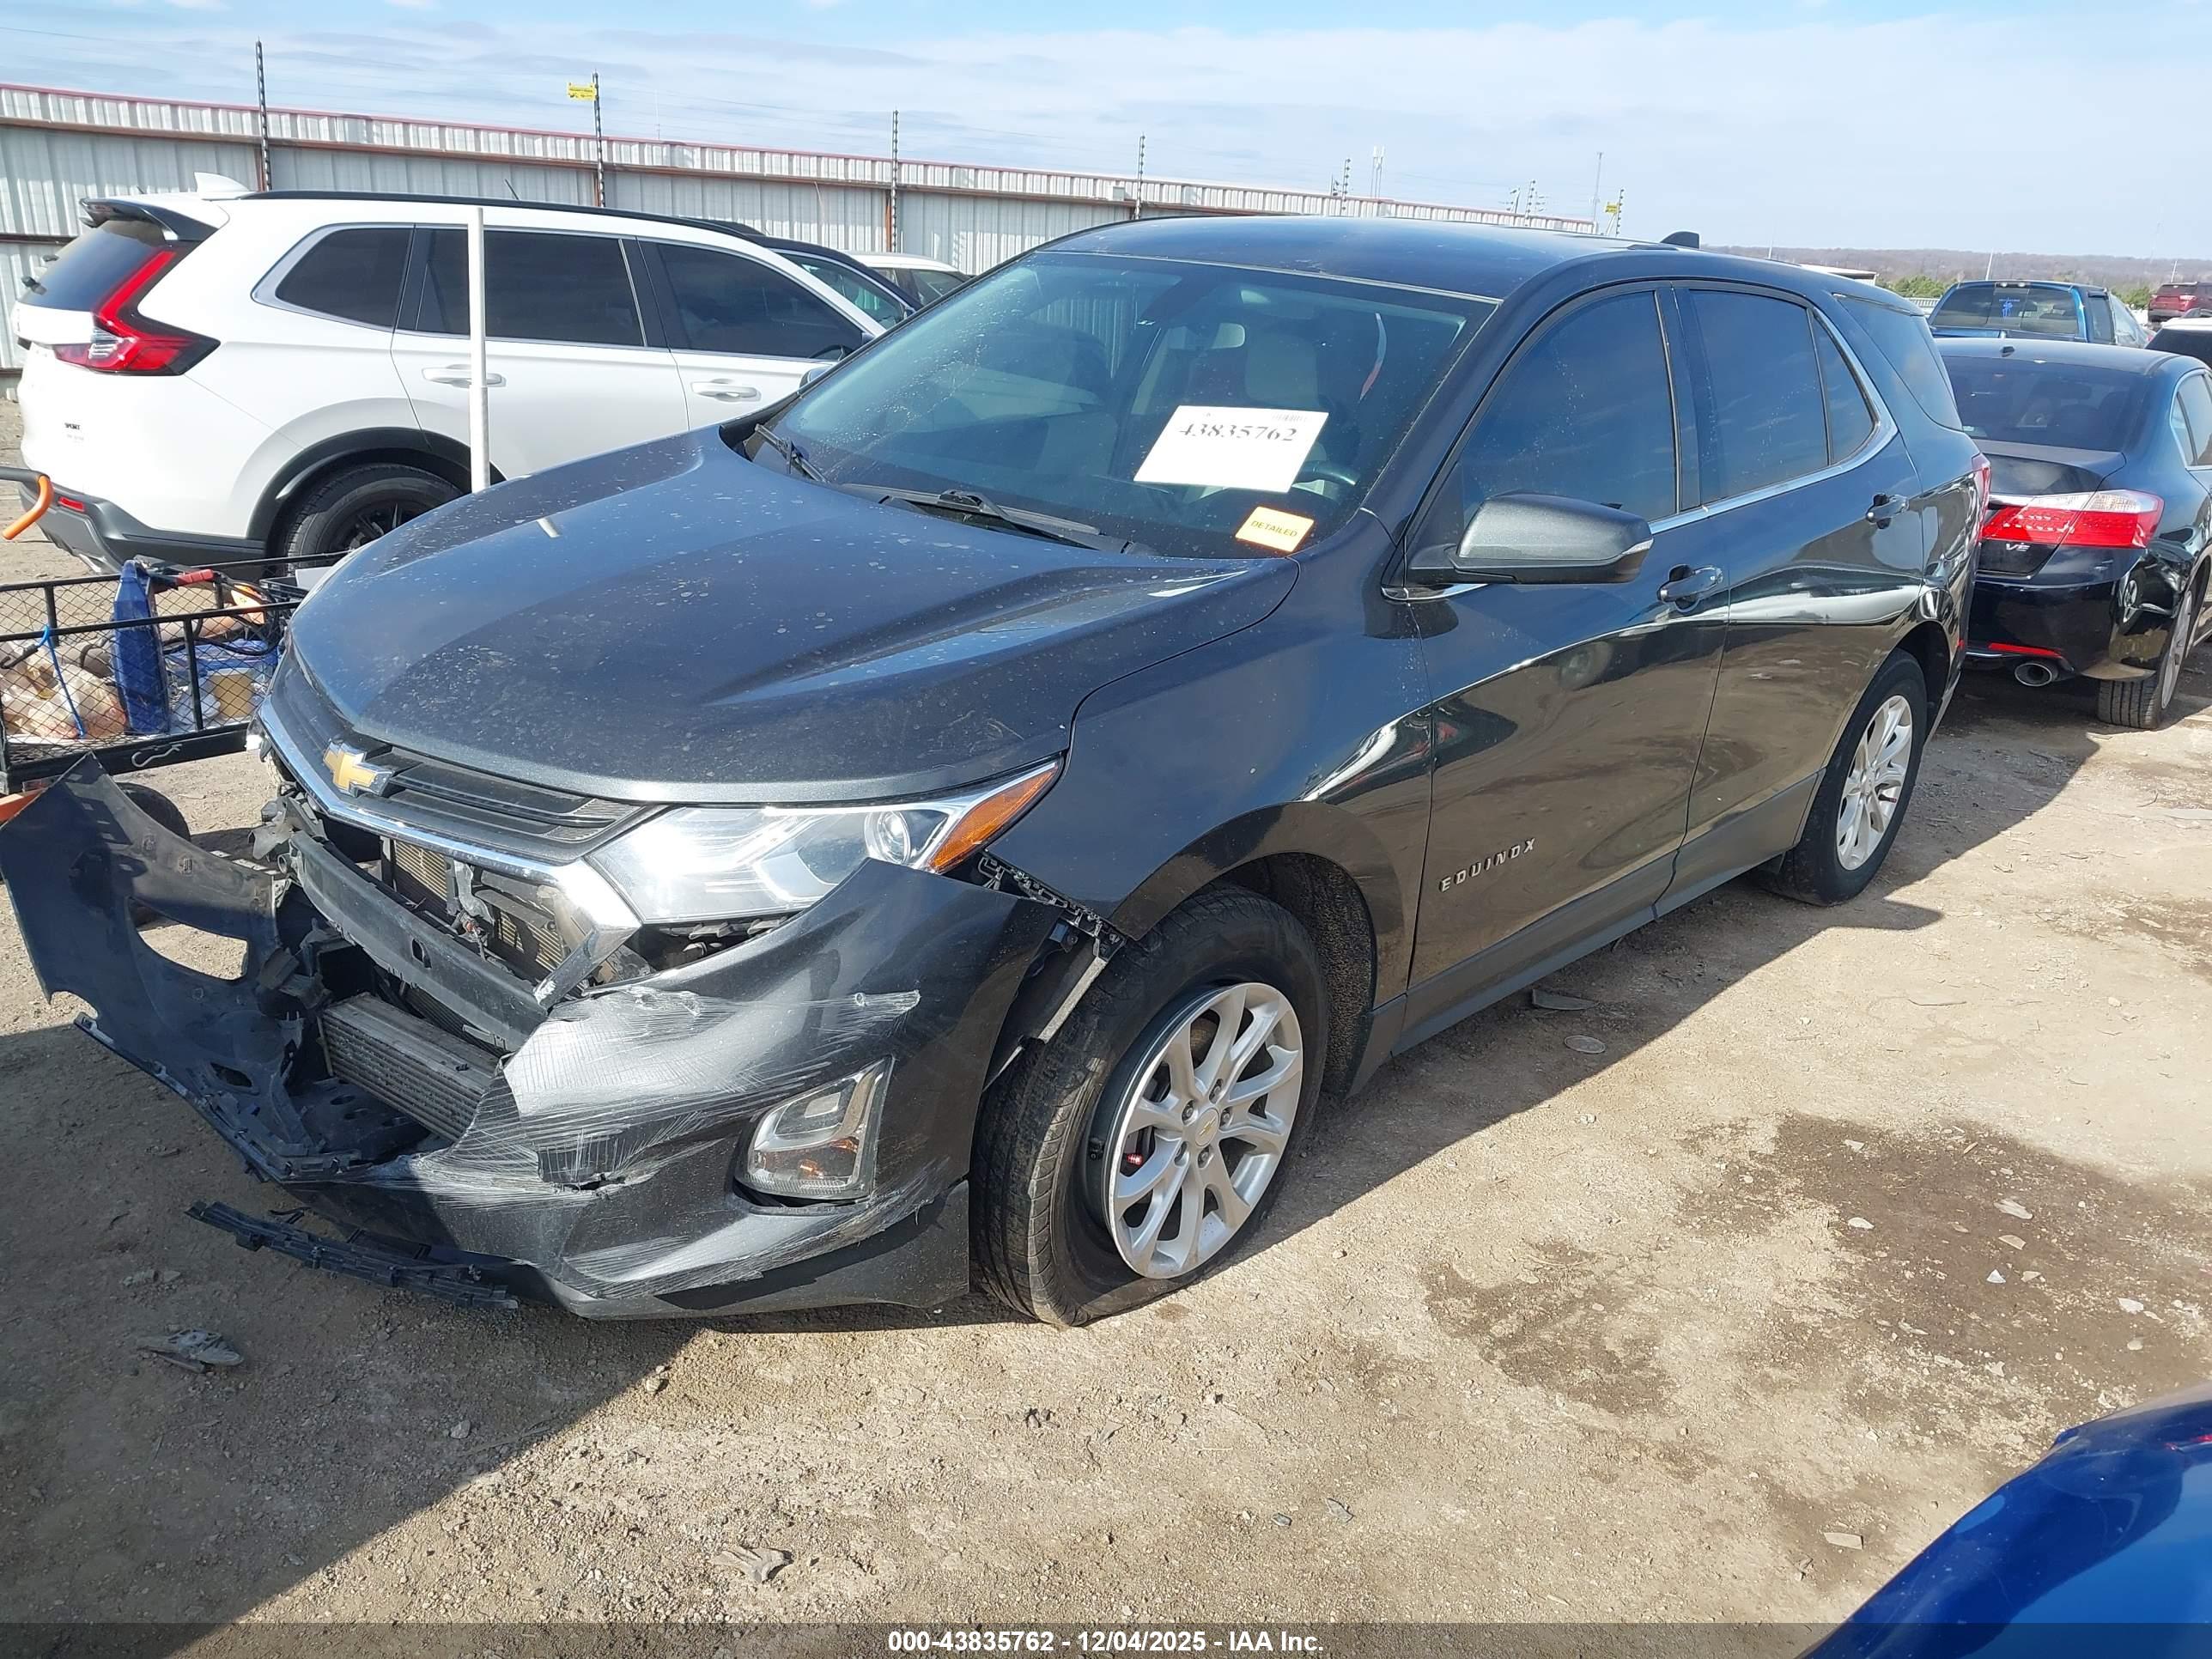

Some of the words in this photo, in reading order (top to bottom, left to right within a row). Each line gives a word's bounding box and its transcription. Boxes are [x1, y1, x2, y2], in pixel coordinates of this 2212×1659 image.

[1180, 422, 1298, 441] 43835762
[1251, 520, 1297, 538] DETAILED
[1439, 837, 1535, 892] EQUINOX
